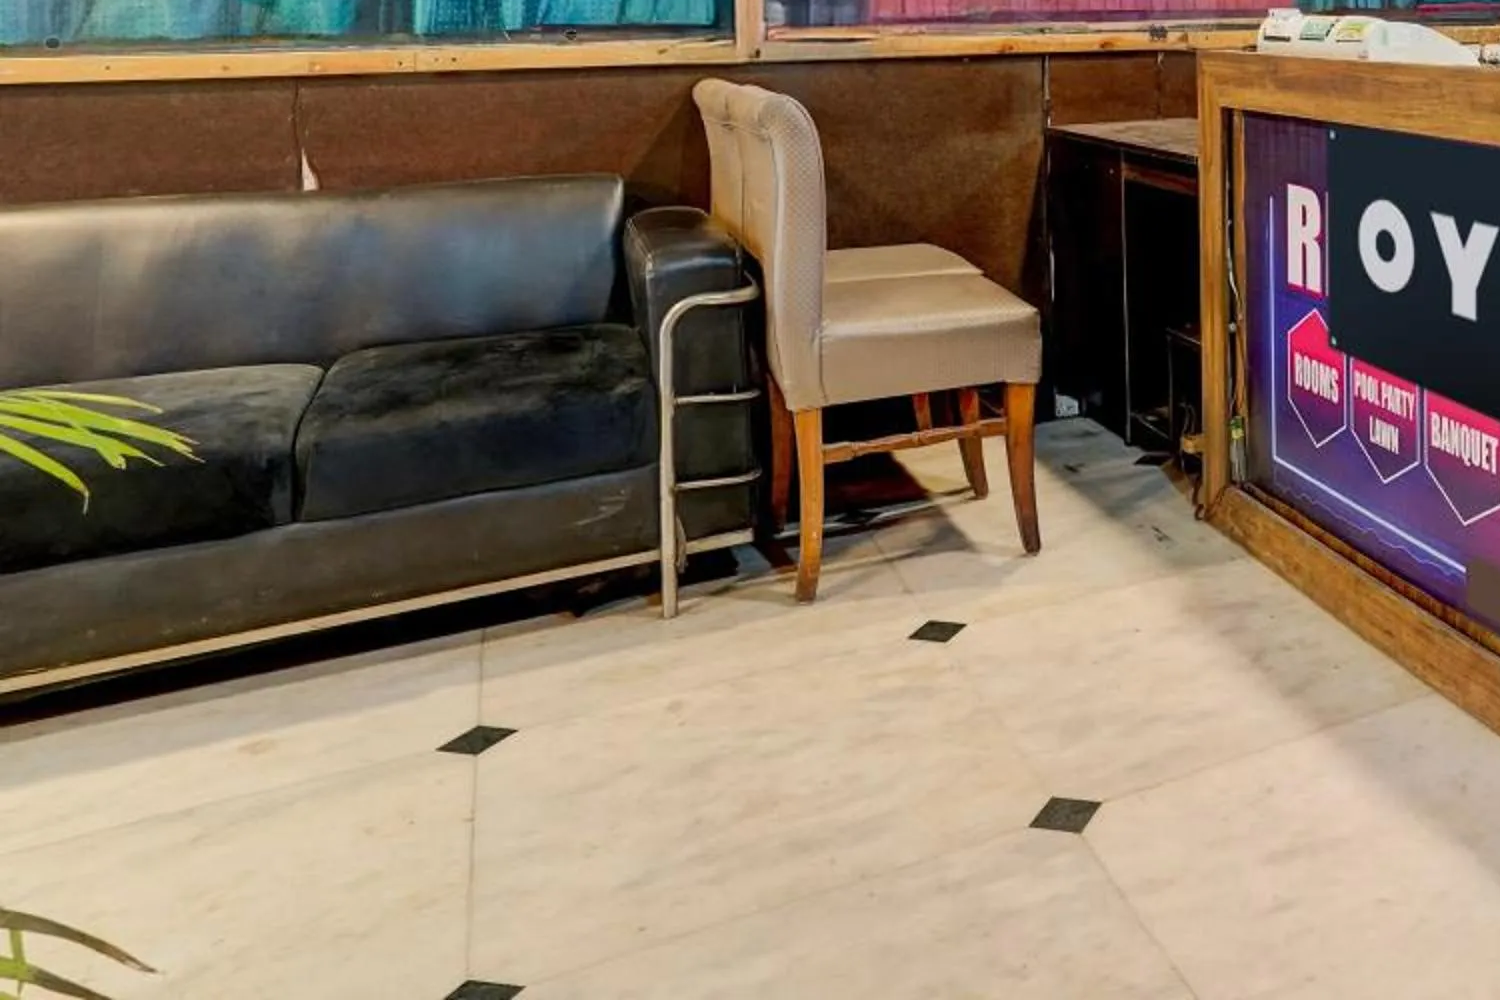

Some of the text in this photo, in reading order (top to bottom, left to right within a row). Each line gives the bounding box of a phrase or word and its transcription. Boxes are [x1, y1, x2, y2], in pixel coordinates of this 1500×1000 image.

[1294, 351, 1339, 405] ROOMS
[1354, 368, 1415, 421] POOL PARTY
[1369, 415, 1399, 455] LAWN
[1430, 411, 1499, 475] BANQUET
